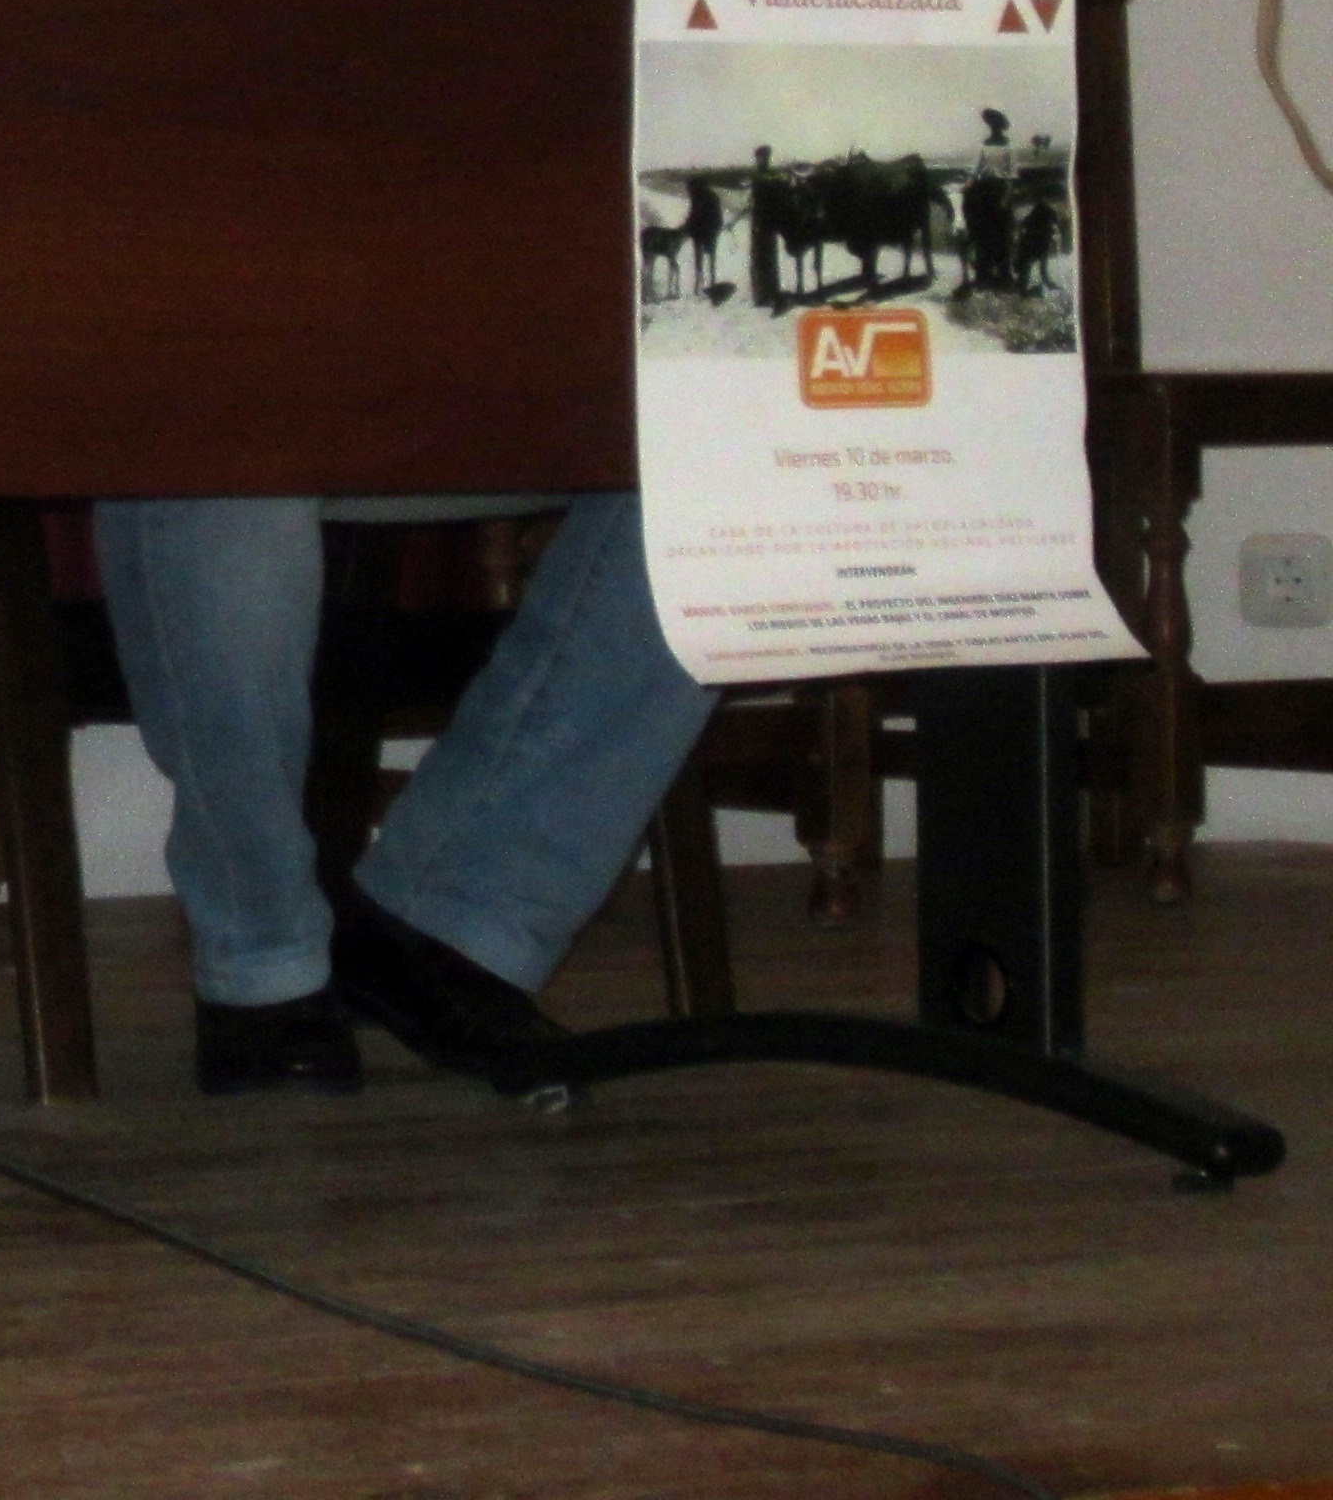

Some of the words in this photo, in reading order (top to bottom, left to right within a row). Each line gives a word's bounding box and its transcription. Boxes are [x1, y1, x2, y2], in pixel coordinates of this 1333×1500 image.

[774, 448, 842, 468] Viernes
[846, 446, 865, 466] 10
[869, 449, 891, 466] de
